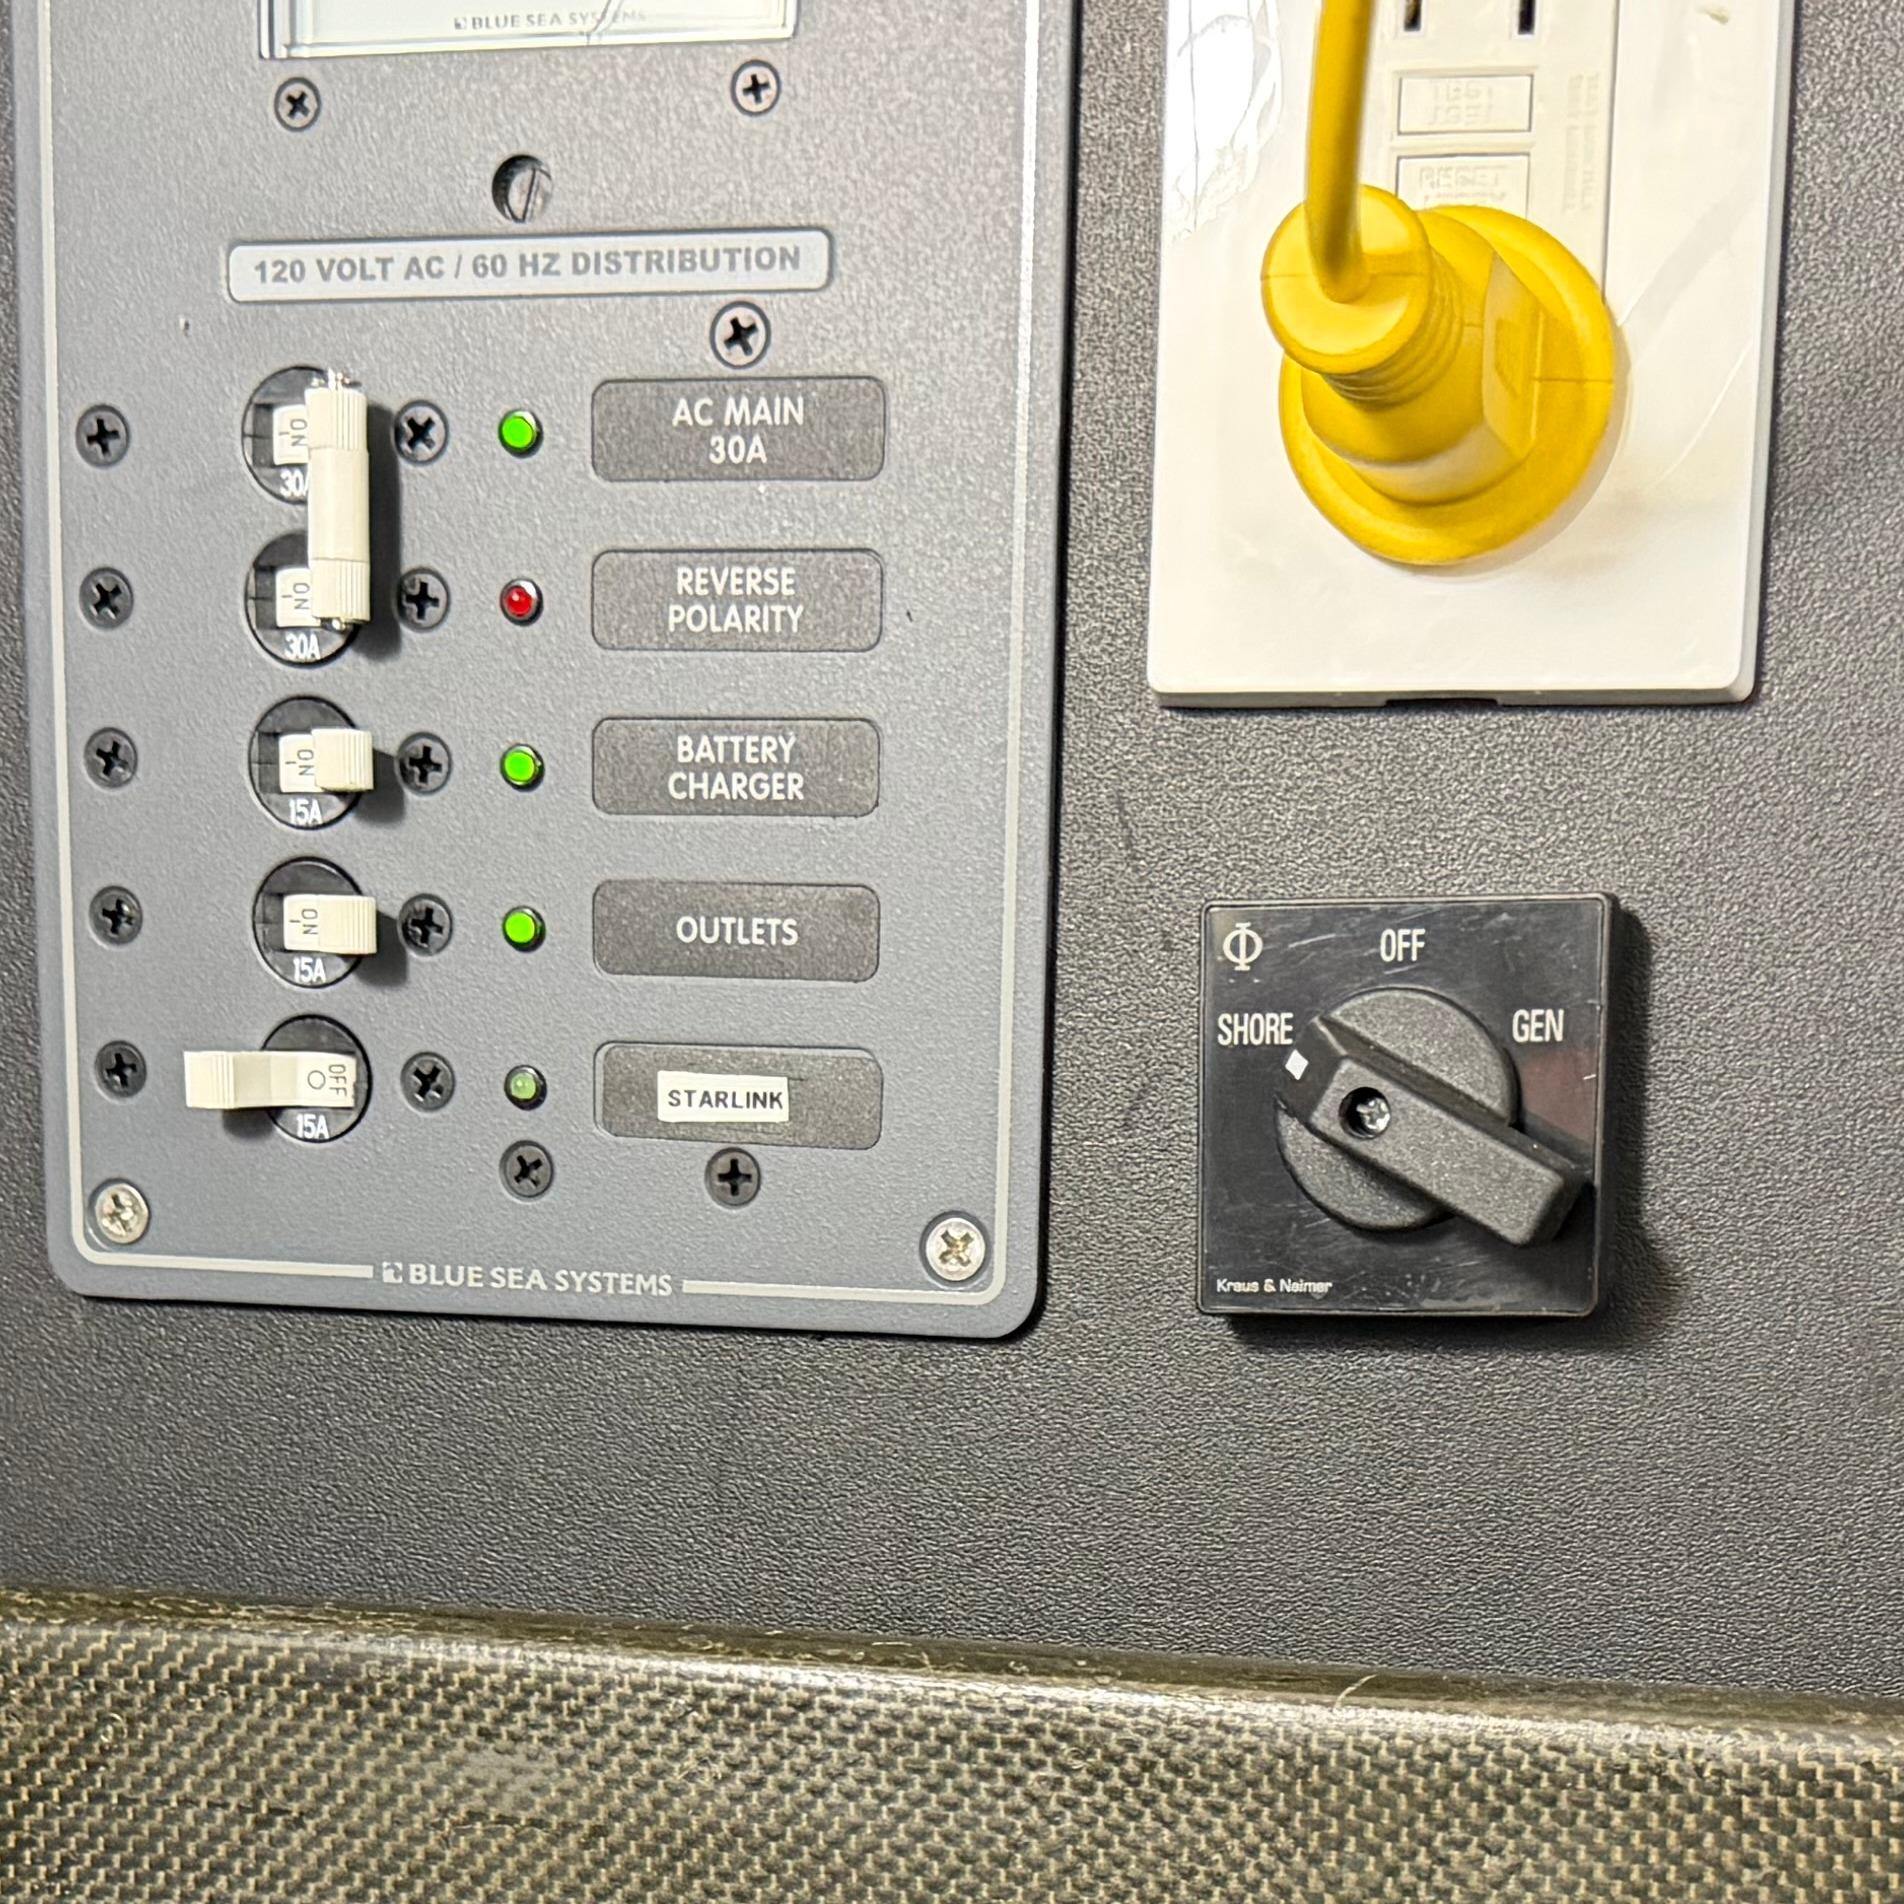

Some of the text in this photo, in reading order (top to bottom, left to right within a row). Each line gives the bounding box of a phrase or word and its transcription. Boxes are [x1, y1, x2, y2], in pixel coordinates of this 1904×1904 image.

[471, 15, 521, 29] BLUE
[527, 14, 562, 27] SEA
[254, 246, 801, 284] 120 VOLT AC / 60 HZ DISTRIBUTION
[672, 396, 805, 427] AC MAIN
[708, 434, 768, 464] 30A
[280, 471, 310, 498] 30
[293, 581, 311, 611] ON
[676, 566, 796, 596] REVERSE
[668, 604, 805, 633] POLARITY
[285, 633, 321, 660] 30A
[297, 748, 315, 776] ON
[676, 734, 797, 764] BATTERY
[667, 771, 805, 801] CHARGER
[289, 799, 324, 826] 15A
[302, 908, 318, 936] ON
[675, 916, 799, 946] OUTLETS
[1380, 928, 1426, 962] OFF
[294, 956, 327, 983] 15A
[1217, 1012, 1294, 1046] SHORE
[1512, 1008, 1565, 1044] GEN
[328, 1063, 347, 1098] OFF
[667, 1089, 783, 1110] STARLINK
[296, 1113, 330, 1140] 15A
[409, 1263, 673, 1297] BLUE SEA SYSTEMS
[1216, 1278, 1260, 1293] Kraus
[1263, 1278, 1277, 1293] &
